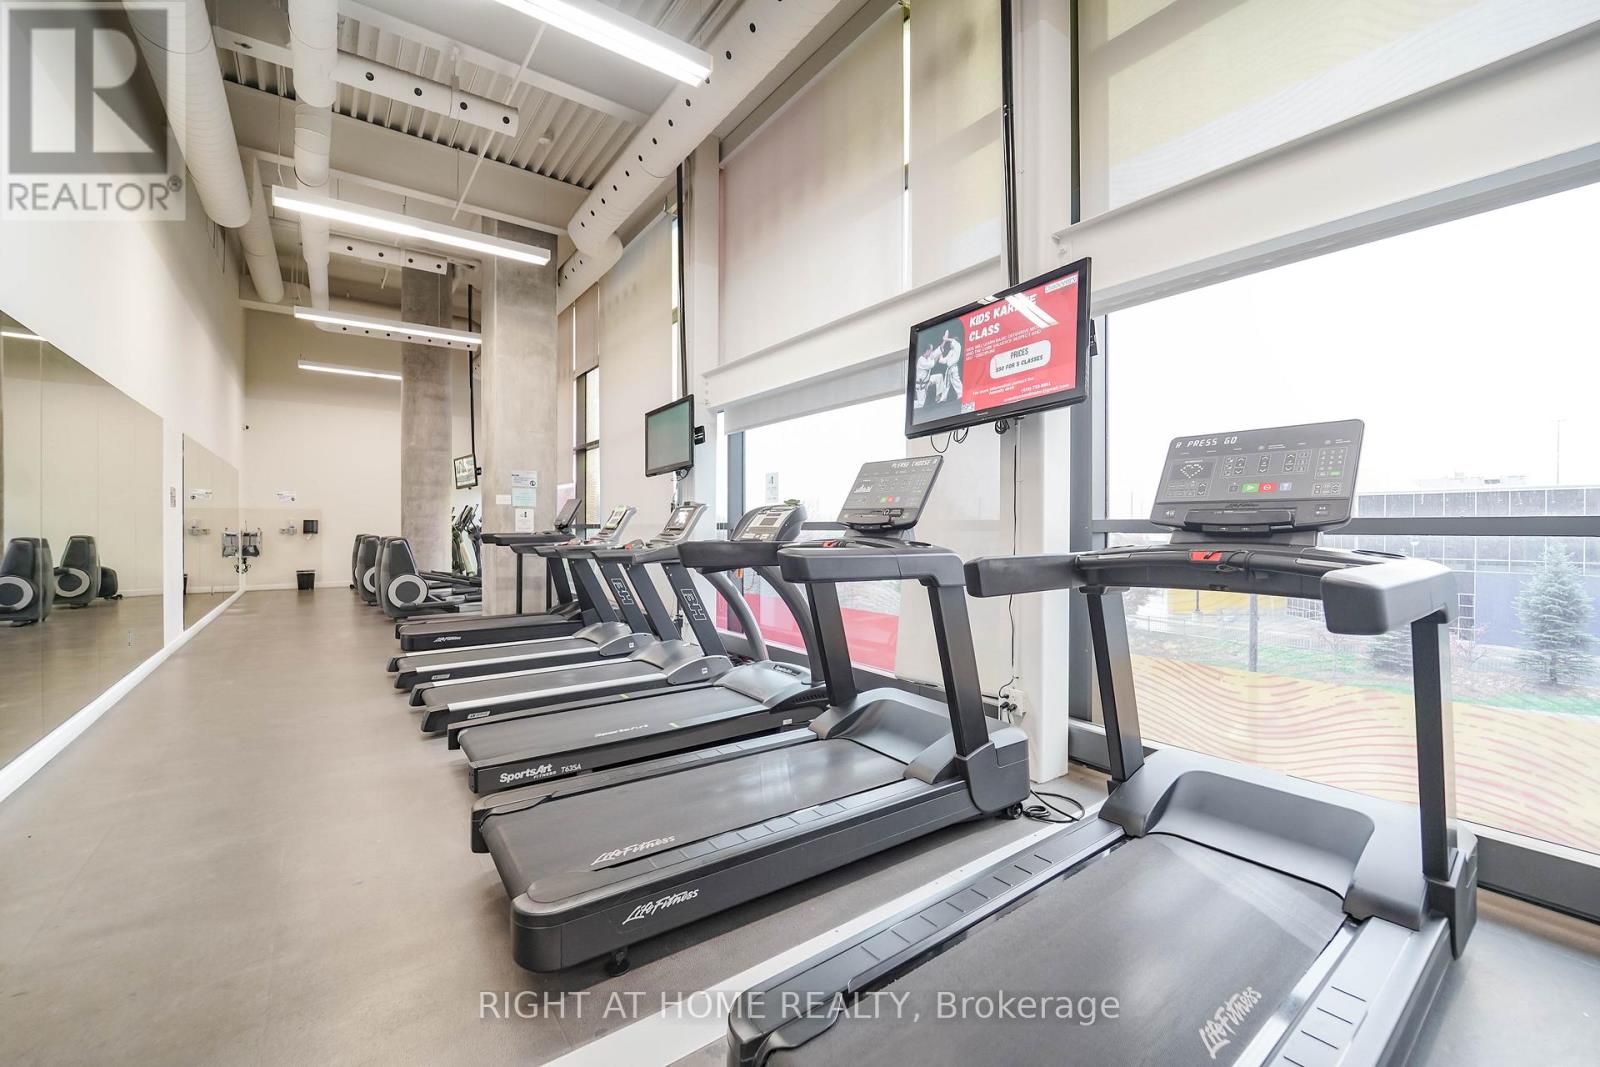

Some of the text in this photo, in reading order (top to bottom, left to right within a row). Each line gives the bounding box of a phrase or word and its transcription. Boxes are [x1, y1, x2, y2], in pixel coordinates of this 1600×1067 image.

[969, 293, 1038, 327] KIDS KARE
[968, 323, 1000, 342] CLASS
[1010, 347, 1029, 359] PRICES
[1021, 354, 1043, 365] CLASSES
[1187, 438, 1218, 447] PRESS
[1224, 436, 1238, 445] GO
[499, 763, 553, 783] SportsArt
